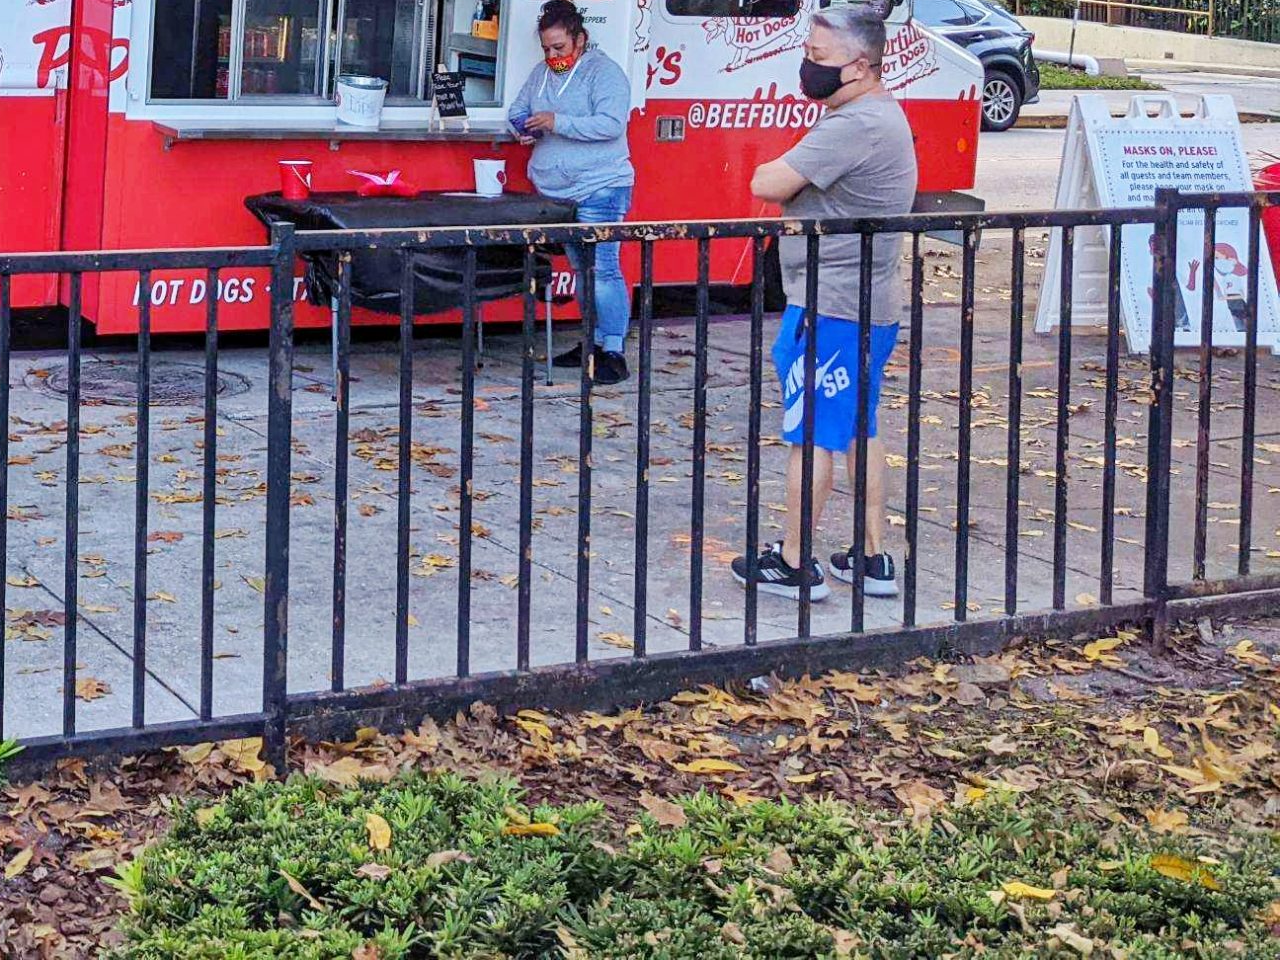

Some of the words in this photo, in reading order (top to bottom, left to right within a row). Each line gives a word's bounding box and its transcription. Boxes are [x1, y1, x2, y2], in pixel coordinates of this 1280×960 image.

[580, 7, 588, 15] OF
[736, 27, 762, 44] HOT
[764, 15, 796, 39] DOGS
[899, 42, 926, 72] DOGS
[688, 102, 828, 130] @BEEFBUSO
[1123, 145, 1157, 156] MASKS
[1159, 146, 1176, 157] ON,
[1178, 146, 1218, 156] PLEASE!
[1122, 160, 1134, 169] For
[1136, 160, 1149, 169] the
[1150, 160, 1174, 169] health
[1175, 160, 1189, 169] and
[1191, 160, 1214, 170] safety
[1216, 160, 1224, 169] of
[1120, 172, 1130, 180] all
[1131, 172, 1156, 181] guests
[1157, 172, 1171, 180] and
[1172, 172, 1192, 180] team
[1193, 172, 1231, 181] members,
[1129, 183, 1154, 192] please
[1194, 183, 1214, 191] mask
[1127, 194, 1141, 202] and
[822, 365, 851, 399] SB
